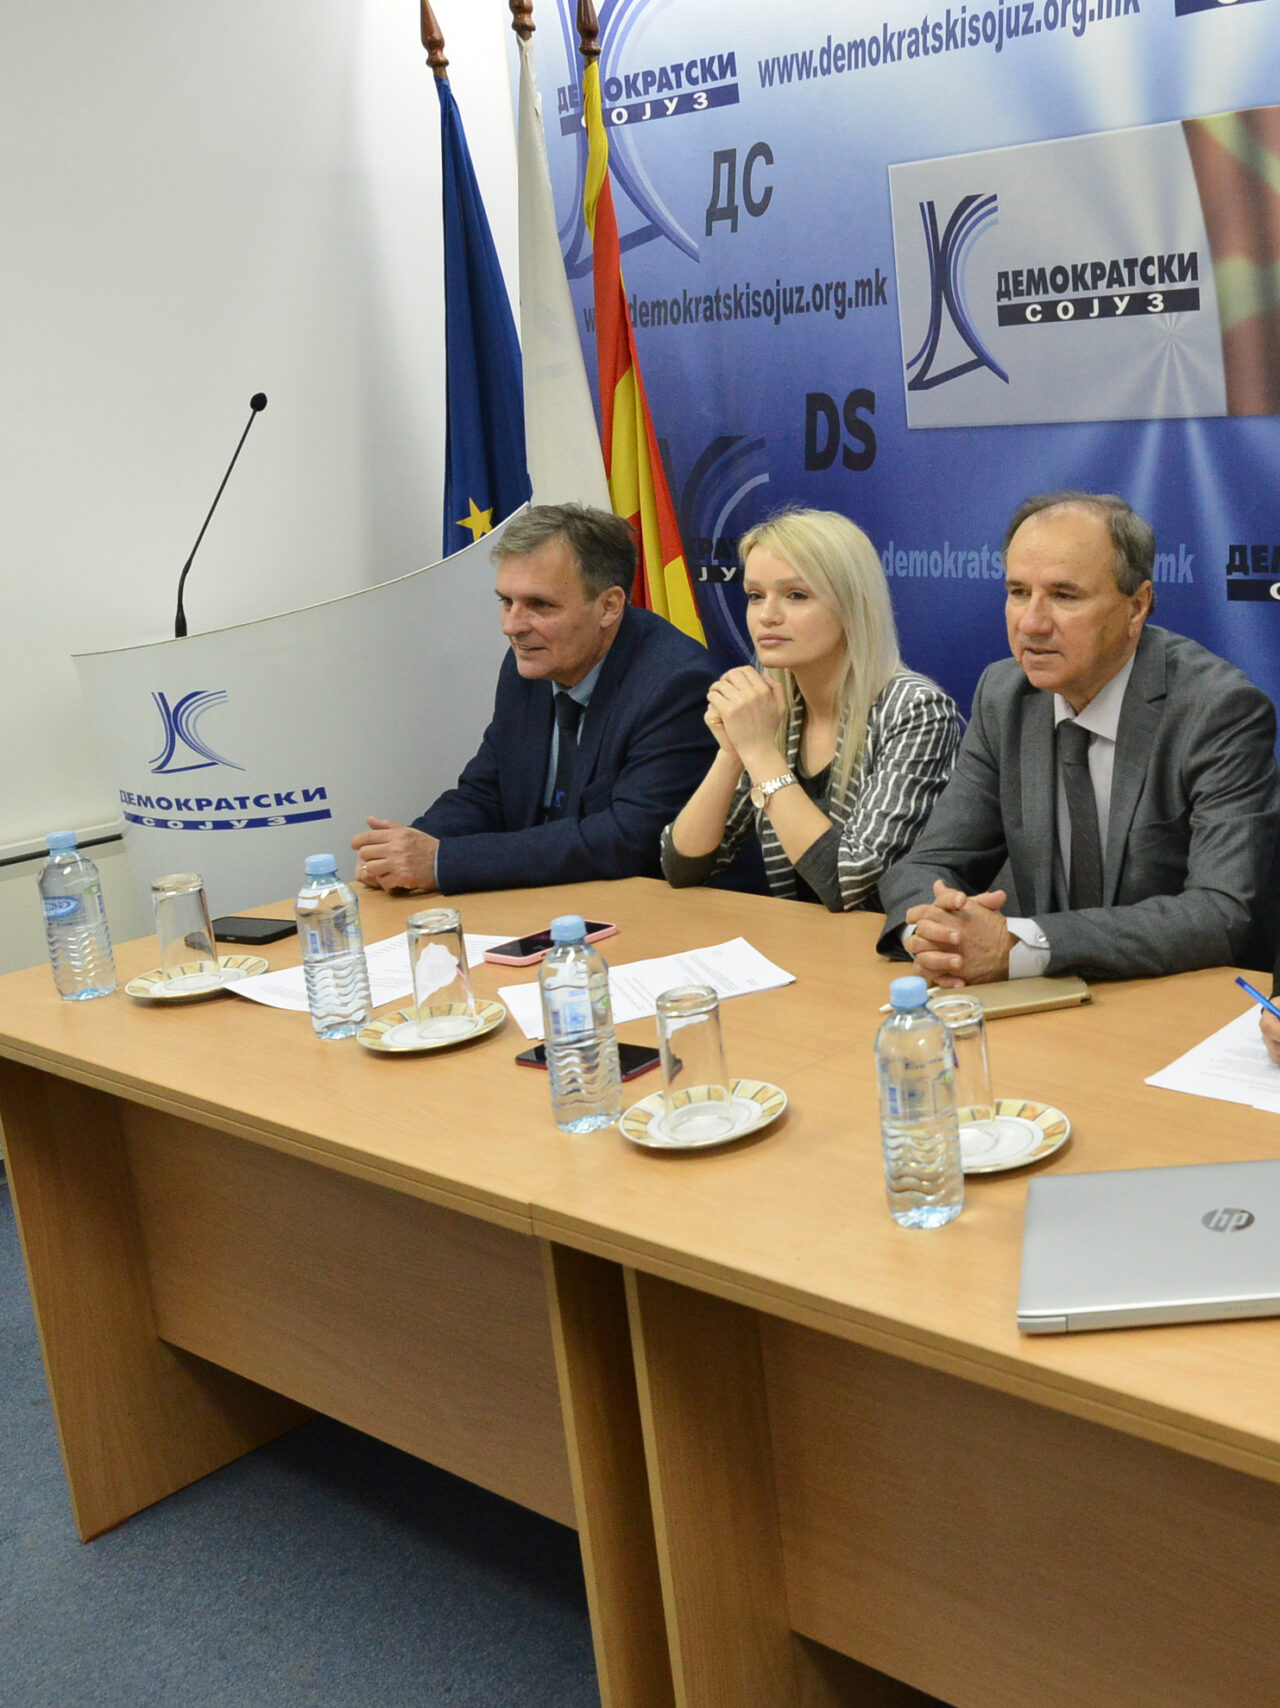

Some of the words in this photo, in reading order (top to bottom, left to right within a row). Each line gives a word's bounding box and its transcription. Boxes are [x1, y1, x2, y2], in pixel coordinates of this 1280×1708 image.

[557, 51, 737, 115] ДЕОКРАТСКИ
[705, 141, 774, 236] ДС
[996, 251, 1199, 302] ДЕМОКРАТСКИ
[1025, 293, 1165, 323] СОЈУЗ
[803, 387, 877, 472] DS
[119, 786, 328, 812] ДЕМОКРАТСКИ
[142, 815, 287, 830] СОЈУЗ
[1207, 1208, 1251, 1233] hp
